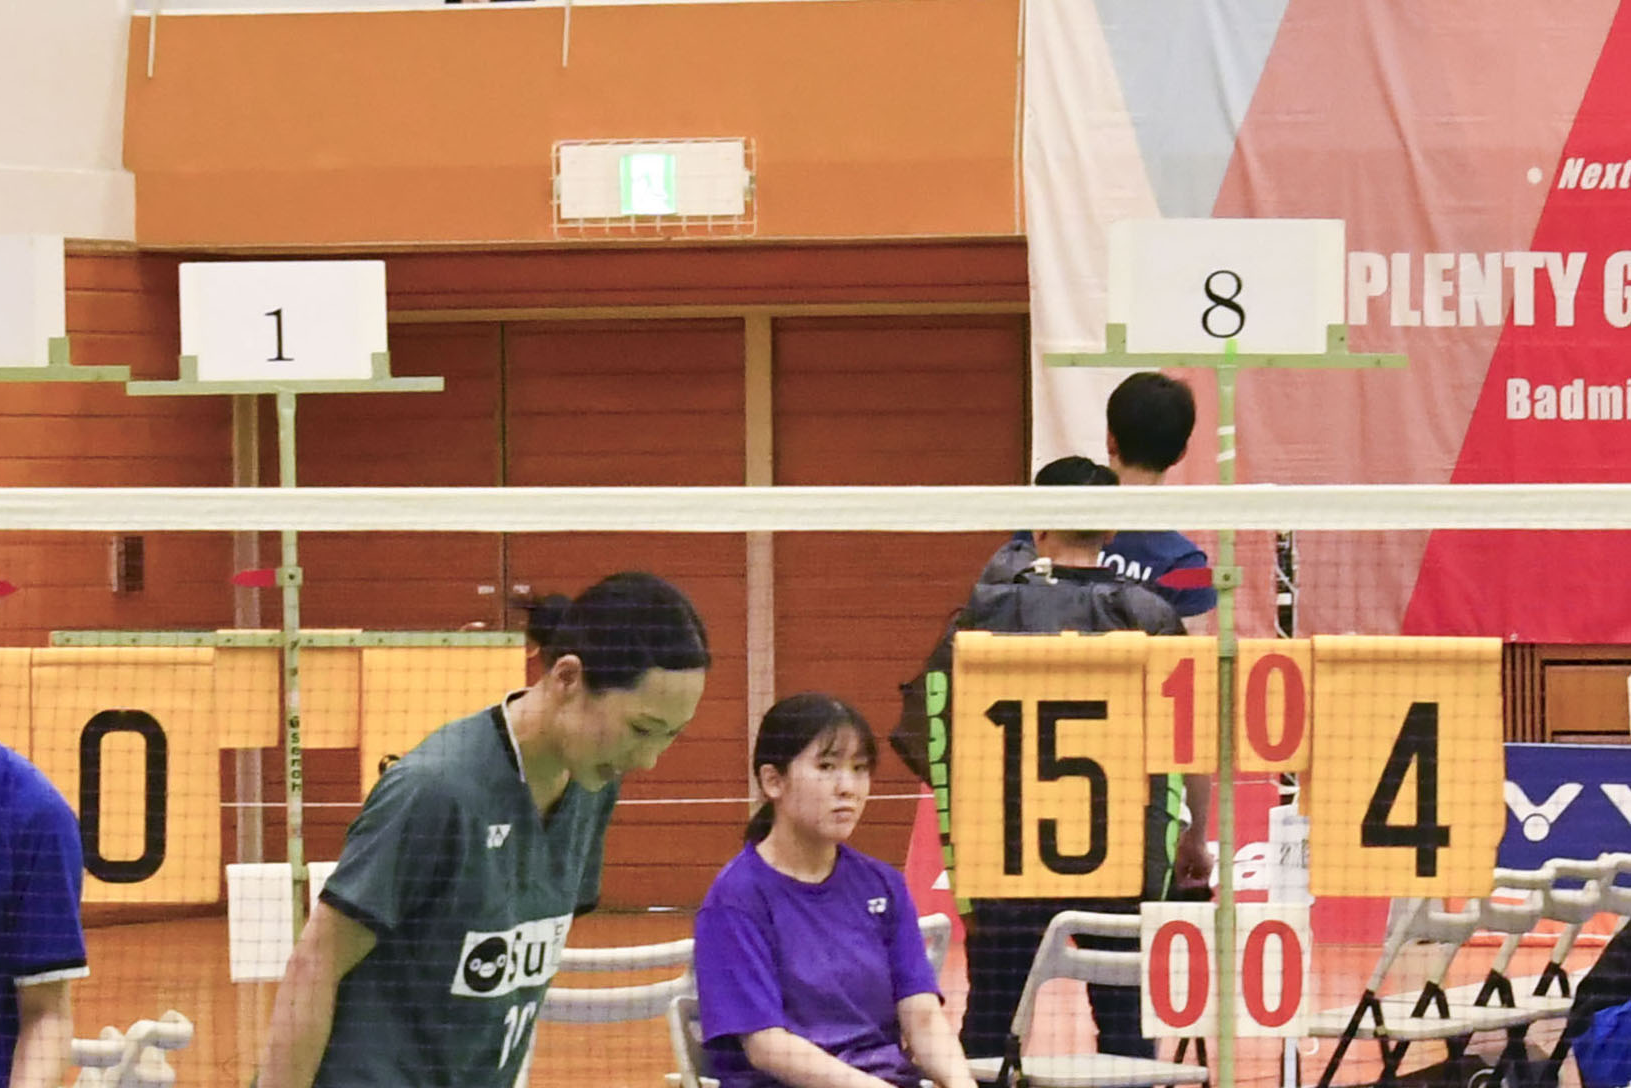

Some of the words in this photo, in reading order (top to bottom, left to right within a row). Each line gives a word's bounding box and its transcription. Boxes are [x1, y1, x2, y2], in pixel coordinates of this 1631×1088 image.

[265, 308, 294, 361] 1
[1202, 270, 1245, 338] 8
[1348, 252, 1587, 327] PLENTY
[1161, 658, 1195, 764] 1
[1245, 653, 1306, 762] 0
[79, 709, 167, 884] 0
[984, 700, 1108, 876] 15
[1361, 702, 1450, 877] 4
[1149, 920, 1209, 1028] 0
[1242, 919, 1302, 1027] 0
